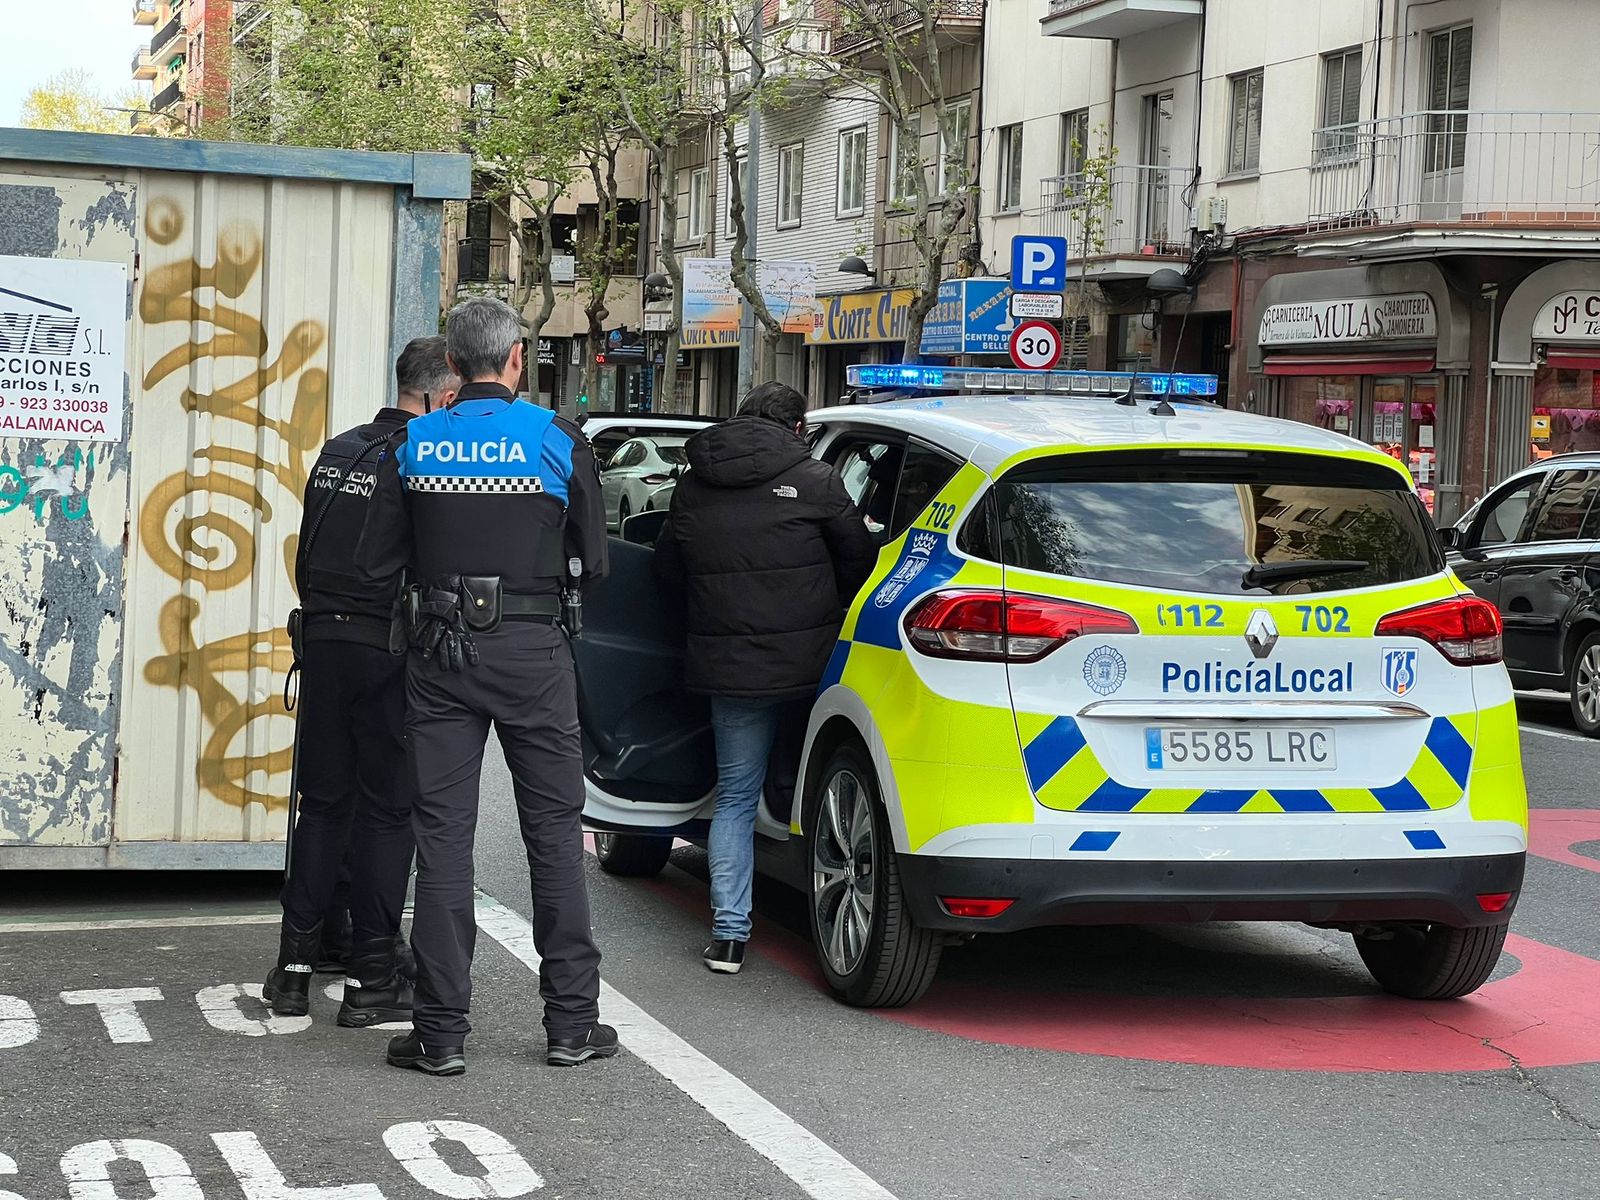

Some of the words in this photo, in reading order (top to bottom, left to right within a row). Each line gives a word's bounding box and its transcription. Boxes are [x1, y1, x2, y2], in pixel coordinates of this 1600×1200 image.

[1022, 242, 1055, 284] P
[939, 286, 957, 298] ERCIAL
[828, 295, 872, 340] CORTE
[877, 290, 910, 338] CHI
[1313, 303, 1385, 339] MULAS
[1386, 318, 1425, 335] JAMONERIA
[83, 328, 111, 356] S.L.
[965, 333, 999, 341] CENTRO
[982, 342, 1009, 350] BELLE
[1021, 338, 1050, 356] 30
[1, 377, 48, 392] arlos
[71, 381, 100, 395] s/n
[20, 396, 48, 411] 923
[53, 399, 108, 414] 330038
[0, 415, 105, 434] ALAMANCA
[417, 437, 526, 463] POLICÍA
[925, 501, 956, 530] 702
[1167, 604, 1225, 627] 112
[1296, 605, 1351, 632] 702
[1385, 651, 1416, 693] 175
[1169, 731, 1254, 763] 5585
[1266, 731, 1328, 763] LRC
[0, 1119, 546, 1200] OLO
